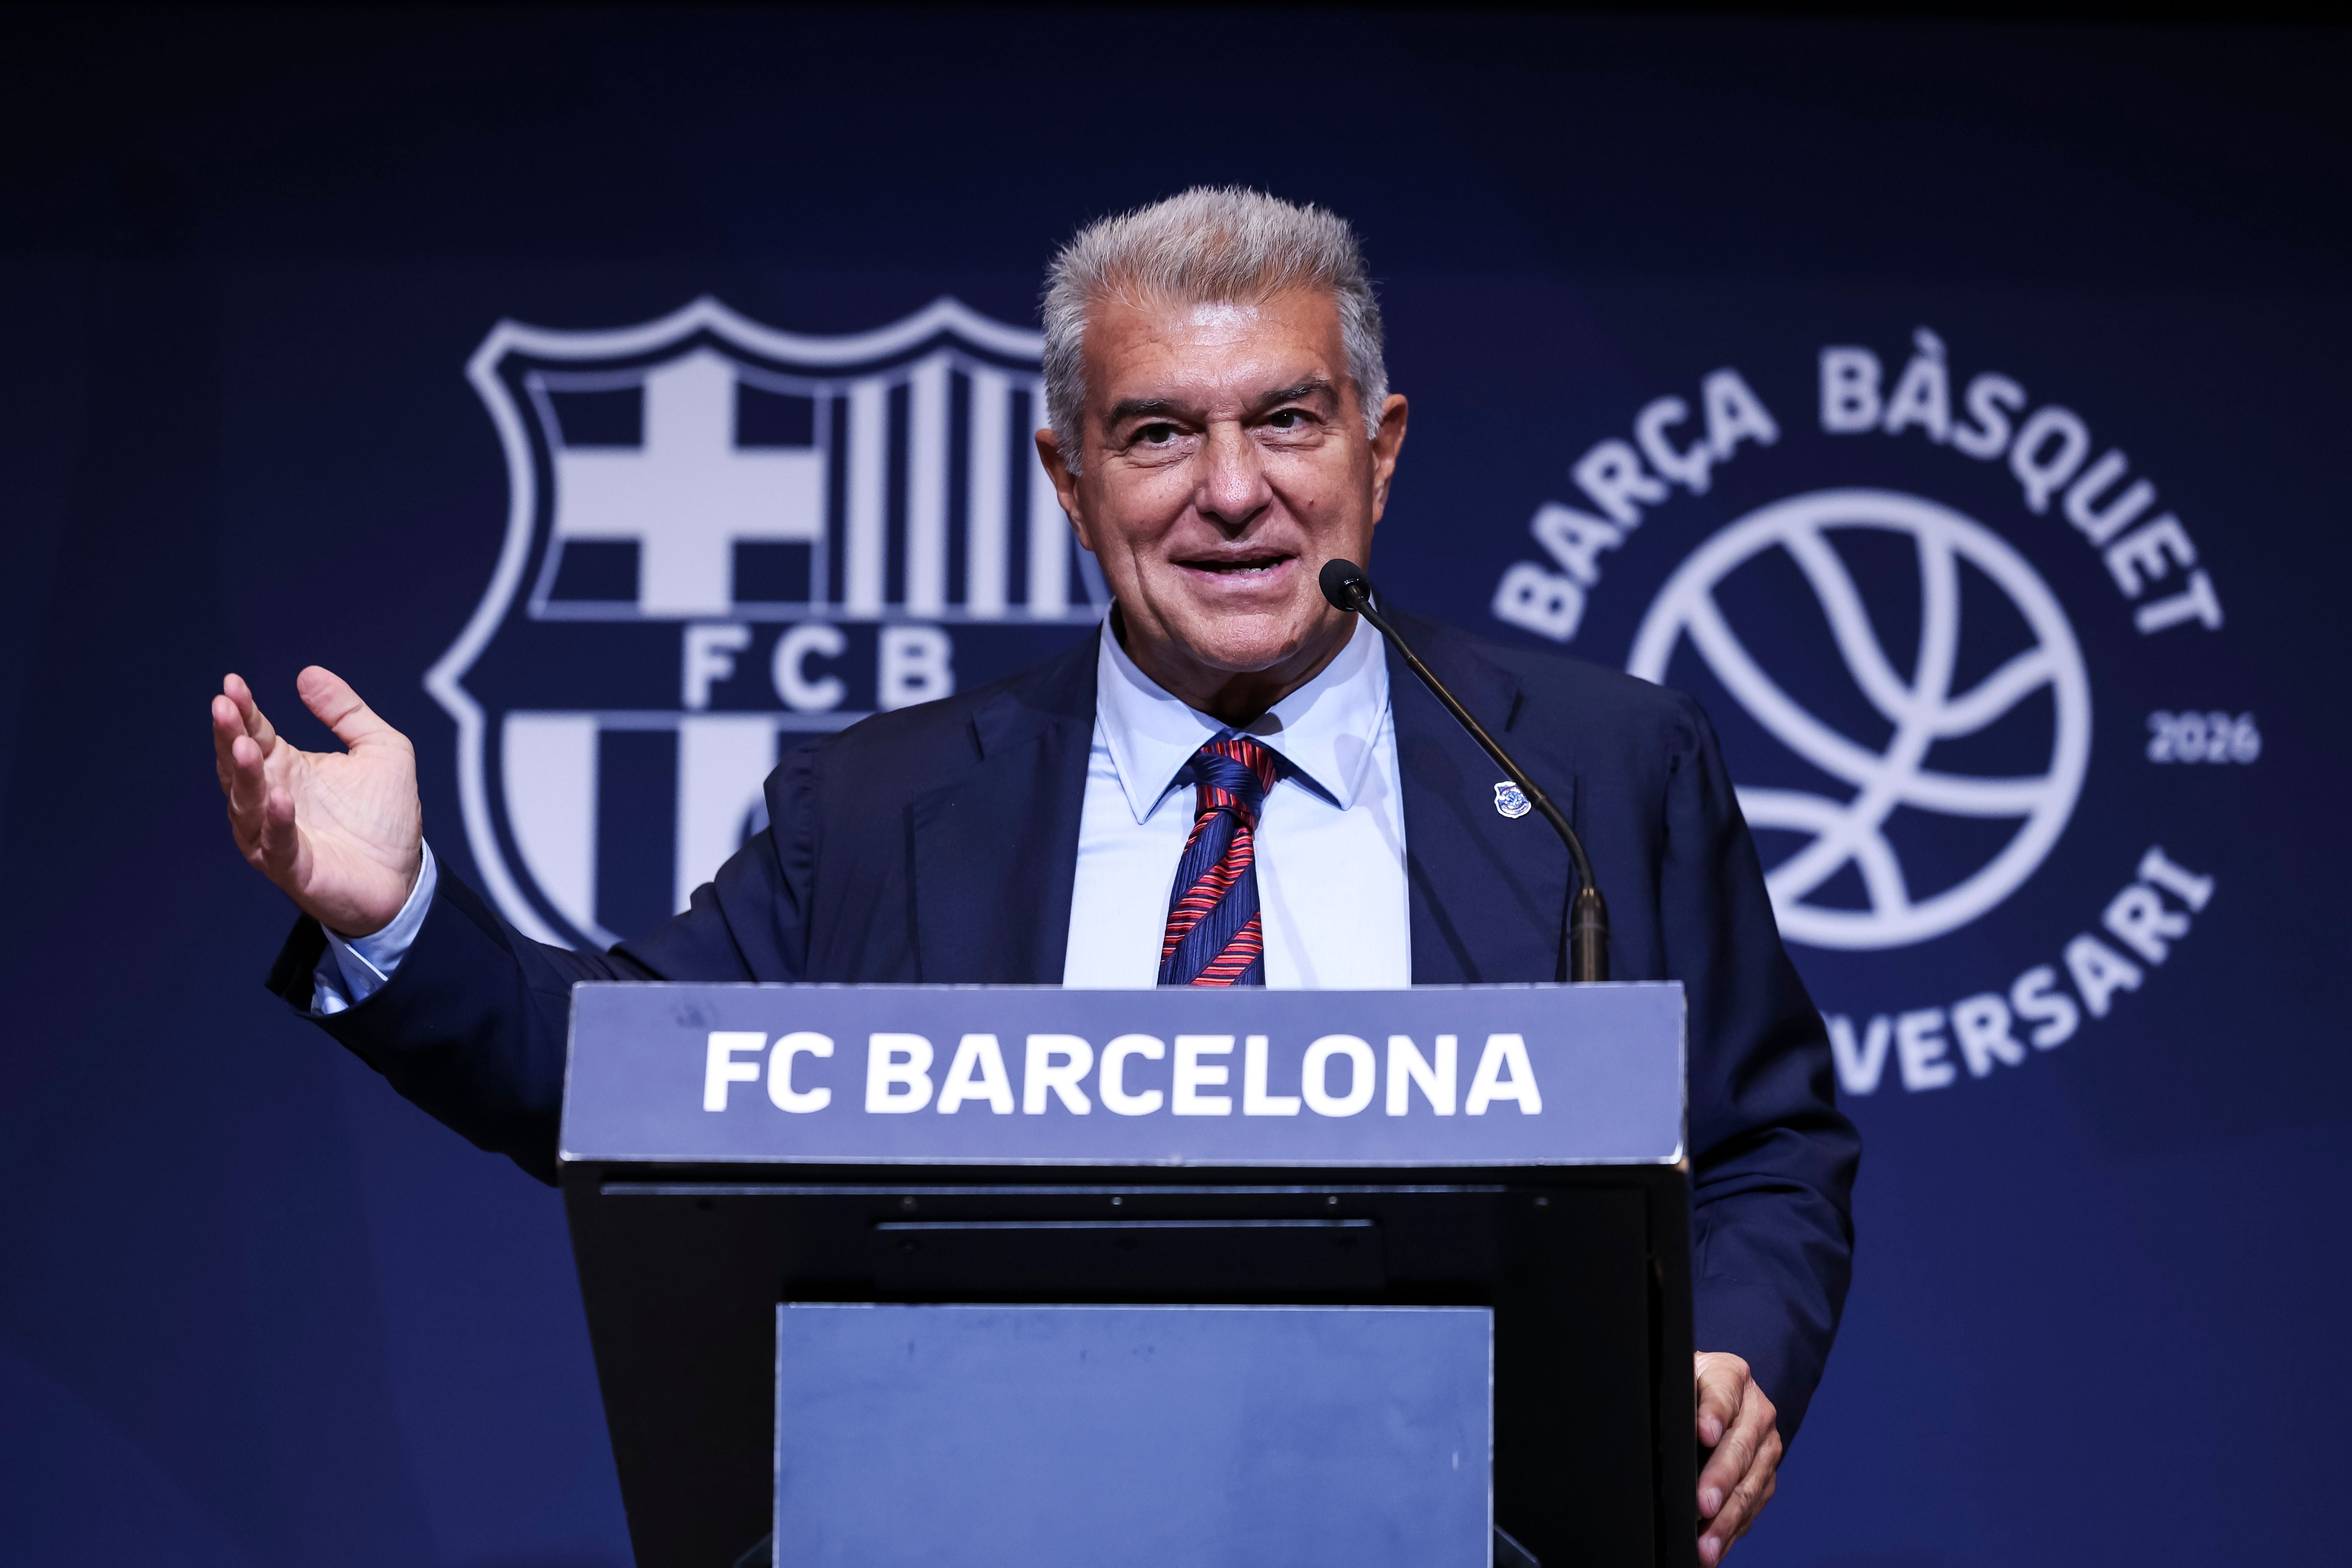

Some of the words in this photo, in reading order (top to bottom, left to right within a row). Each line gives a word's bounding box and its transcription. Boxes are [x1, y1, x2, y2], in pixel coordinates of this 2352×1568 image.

[1491, 367, 1780, 642] BARÇA
[1819, 325, 2223, 634] BÀSQUET
[681, 623, 956, 713] FCB
[2146, 710, 2262, 764] 2026
[1821, 845, 2216, 1096] VERSARI
[702, 1031, 834, 1114] FC
[864, 1033, 1543, 1117] BARCELONA
